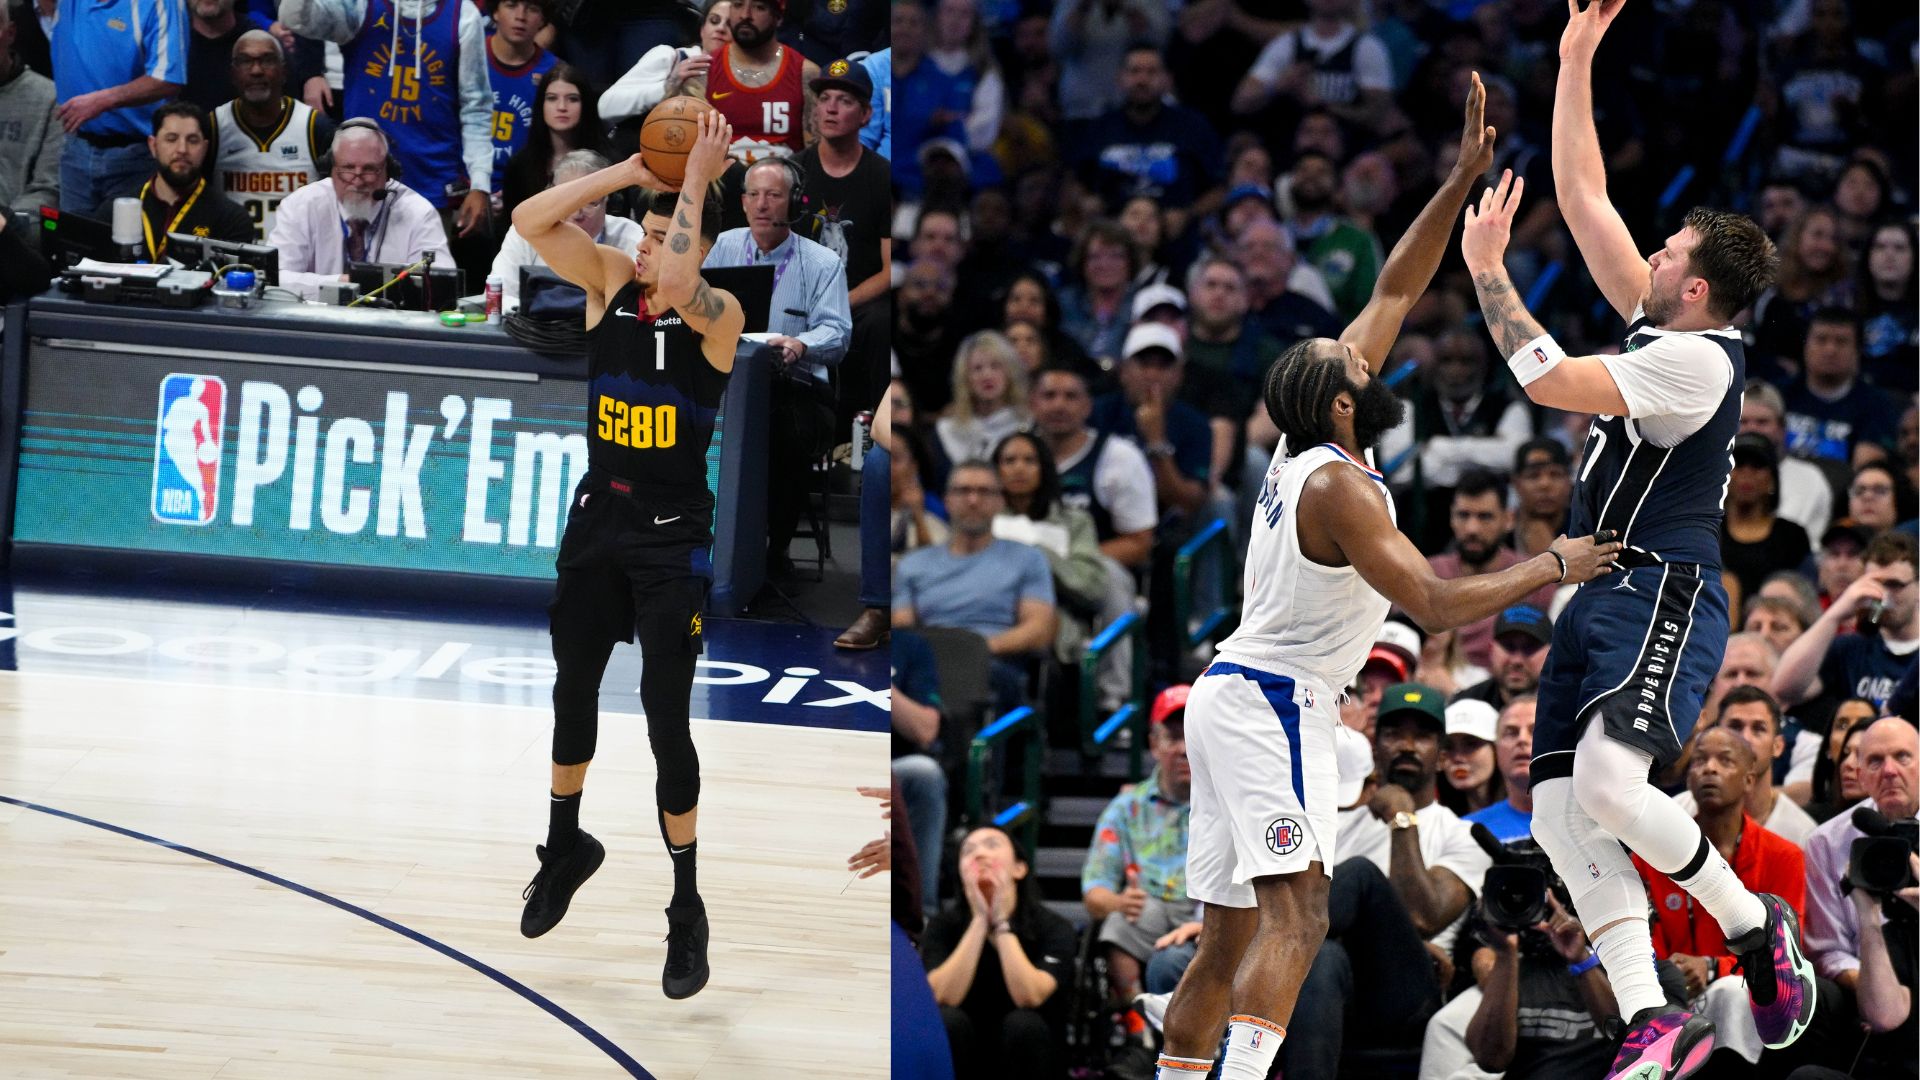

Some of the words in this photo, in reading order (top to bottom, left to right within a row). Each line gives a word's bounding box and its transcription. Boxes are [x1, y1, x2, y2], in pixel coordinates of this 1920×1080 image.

[391, 65, 420, 102] 15
[380, 101, 422, 123] CITY
[762, 101, 790, 134] 15
[494, 145, 512, 159] TY
[223, 171, 308, 193] NUGGETS
[655, 317, 682, 327] ibotta
[655, 331, 665, 370] 1
[598, 394, 677, 449] 5280
[160, 488, 193, 514] NBA
[0, 610, 559, 685] oogle
[1517, 1007, 1604, 1039] ESP
